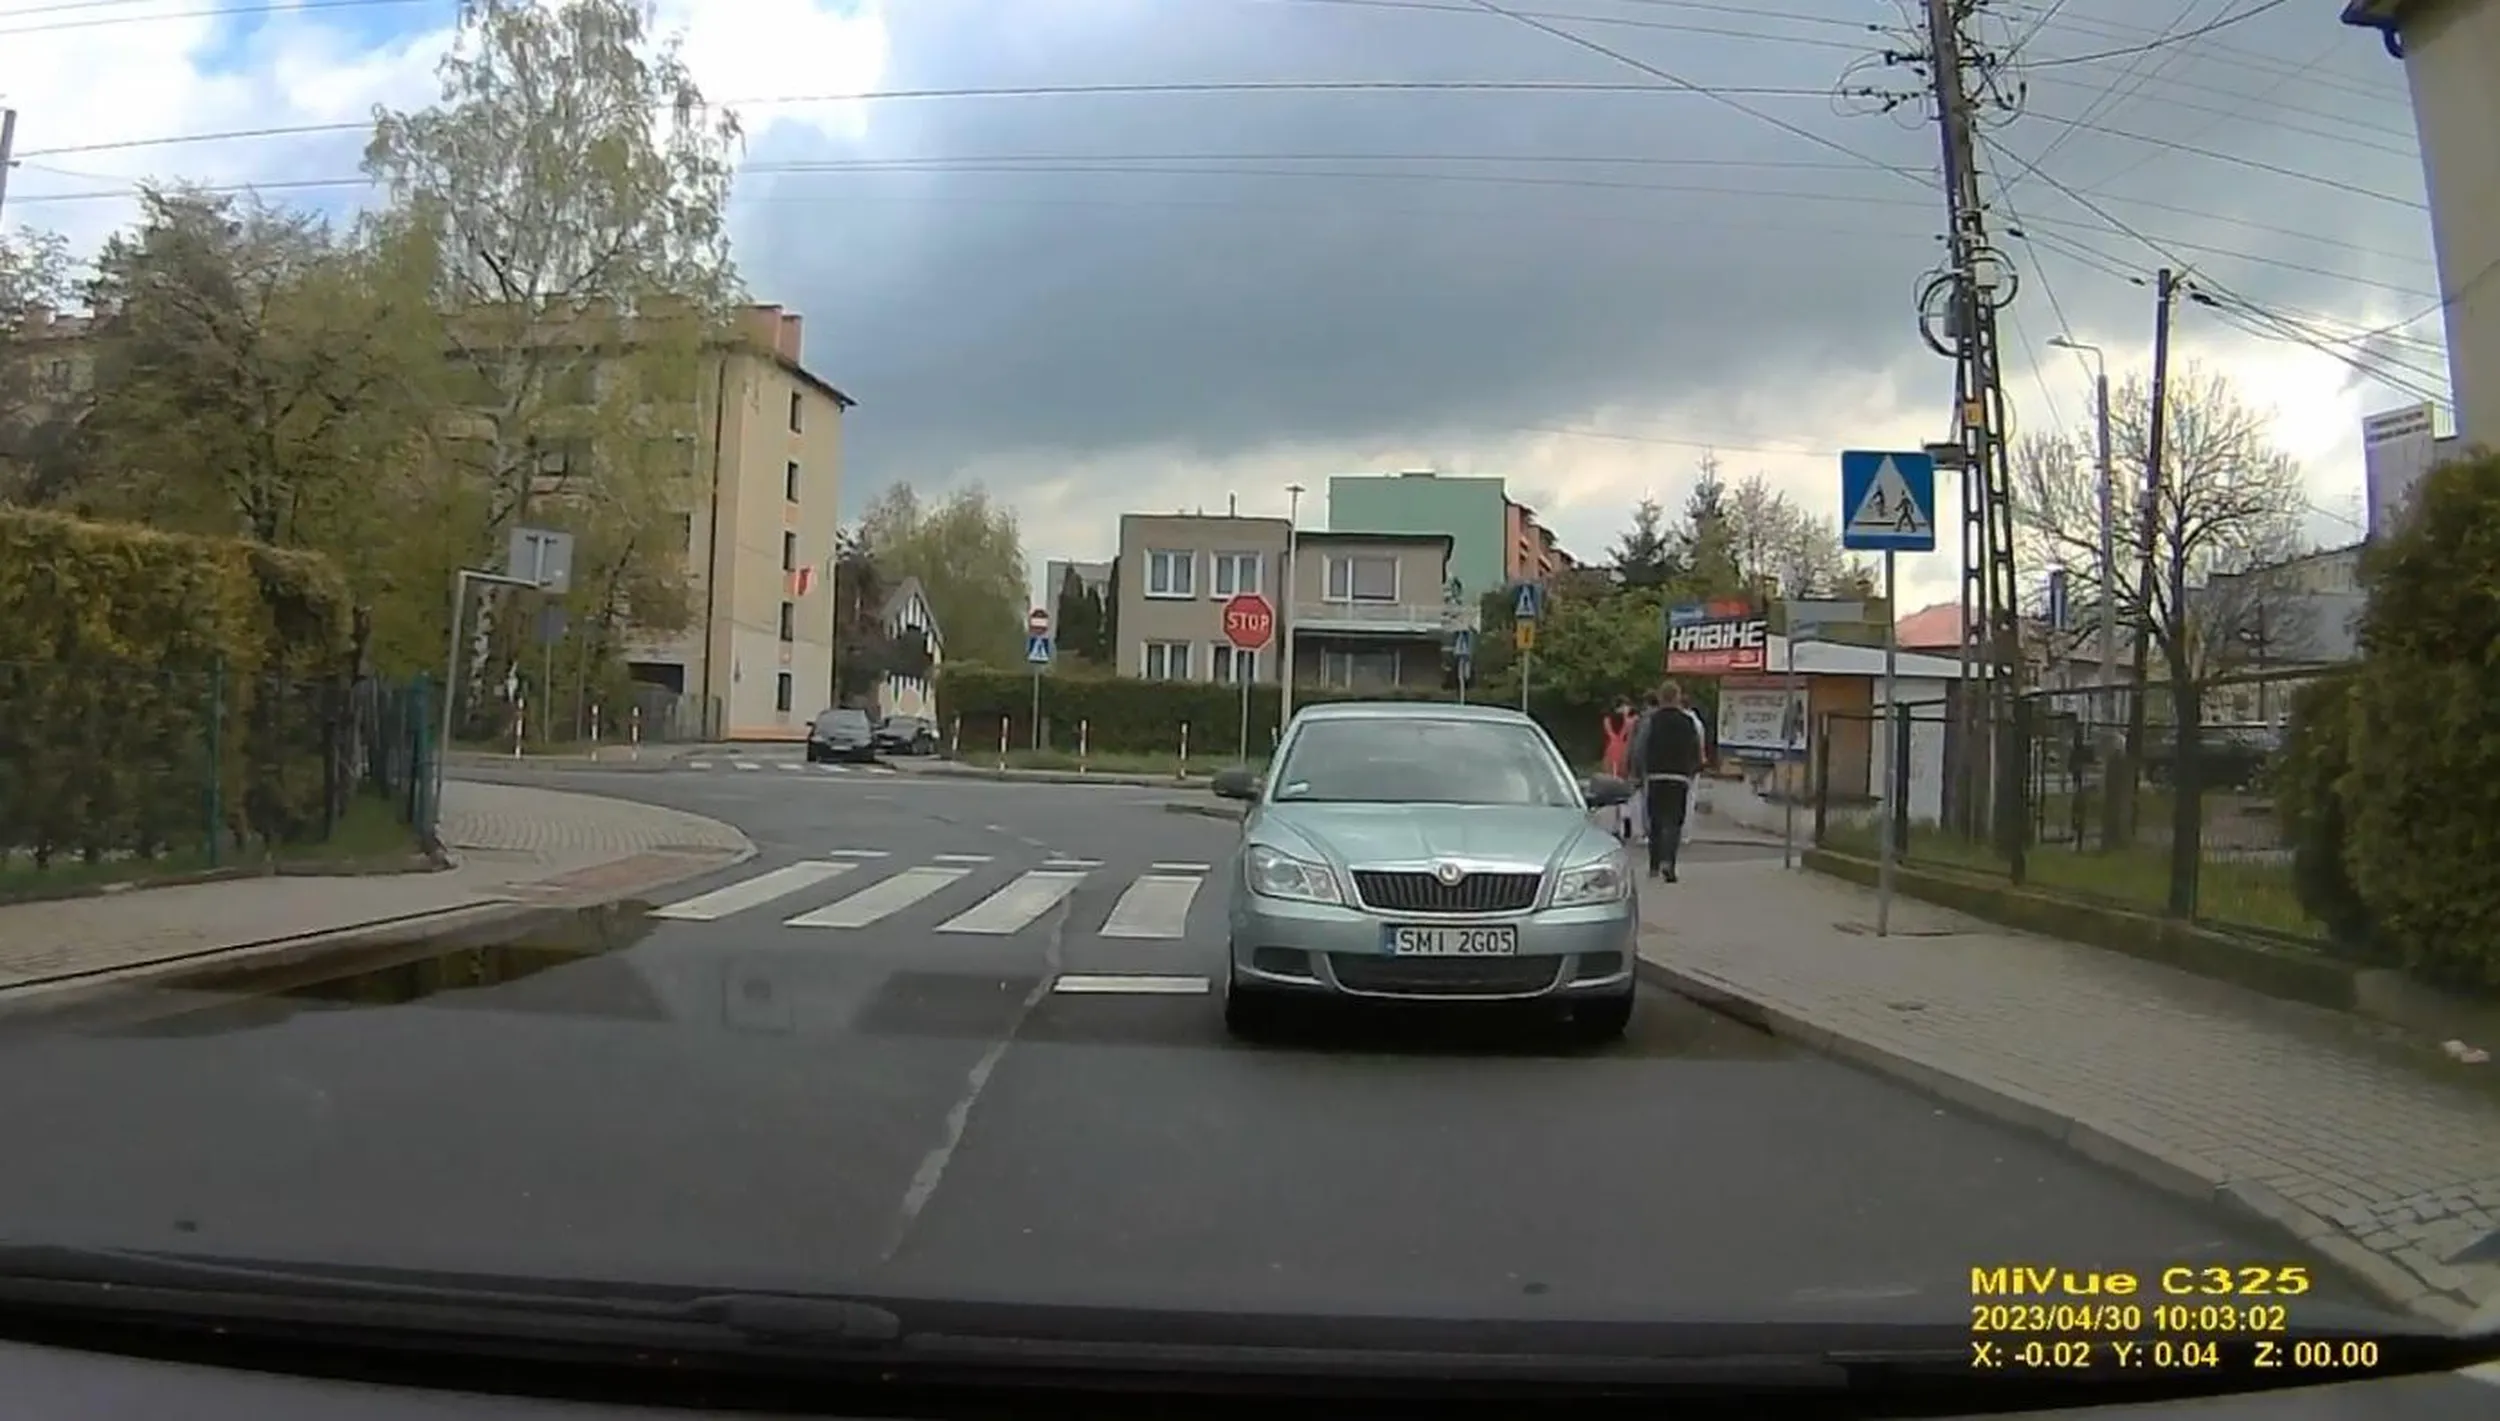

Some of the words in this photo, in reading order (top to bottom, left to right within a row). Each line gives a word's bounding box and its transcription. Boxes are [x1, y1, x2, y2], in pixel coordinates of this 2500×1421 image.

[1227, 611, 1270, 631] STOP
[1400, 930, 1444, 953] SMI
[1458, 931, 1512, 953] 2G05
